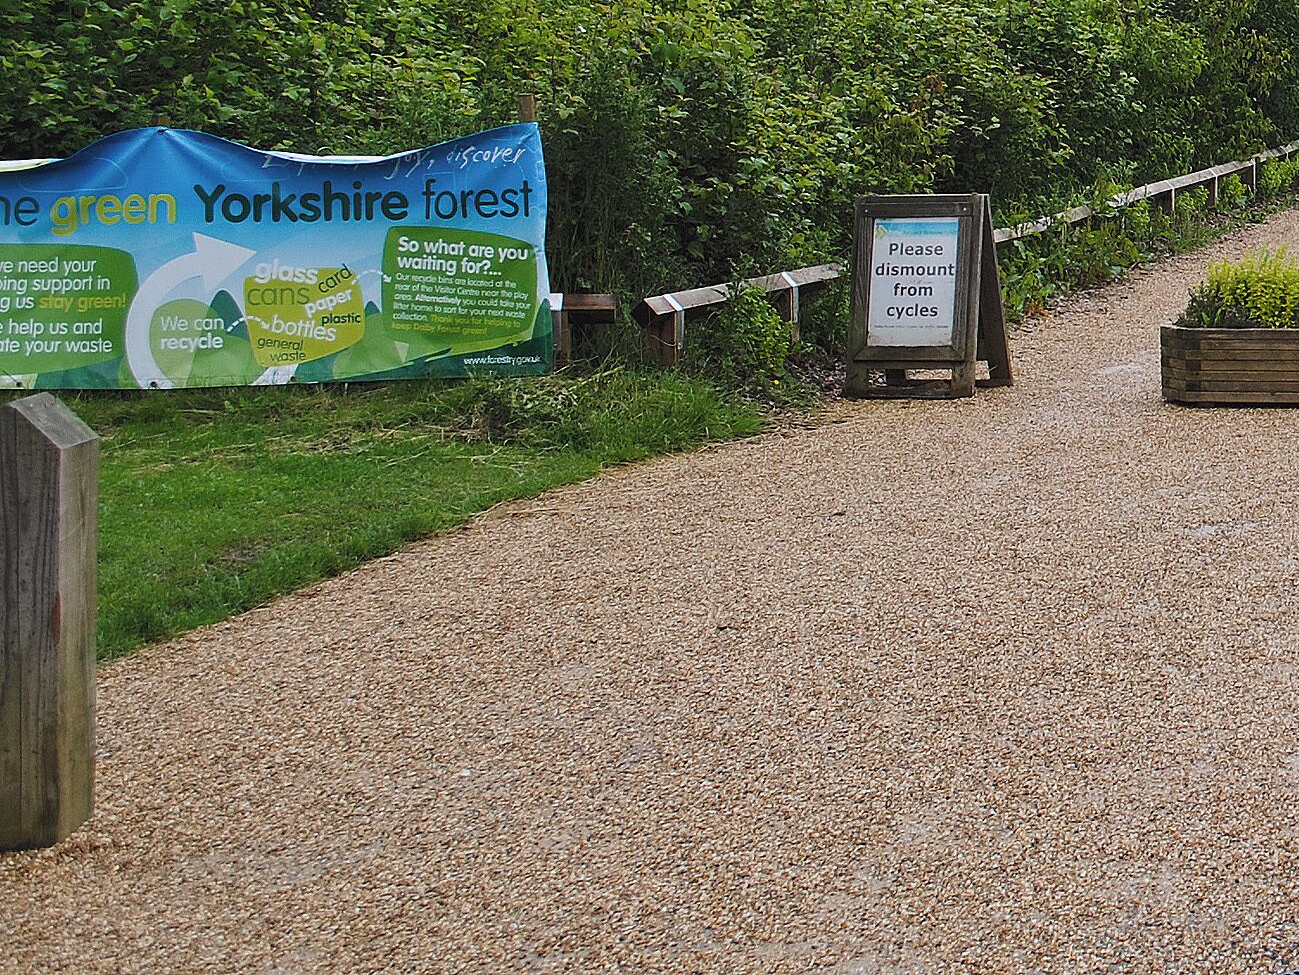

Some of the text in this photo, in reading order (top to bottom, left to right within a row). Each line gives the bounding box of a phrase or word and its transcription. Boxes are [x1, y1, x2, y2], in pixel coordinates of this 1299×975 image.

[50, 193, 176, 236] green
[193, 180, 410, 223] Yorkshire
[421, 178, 533, 220] forest
[397, 236, 528, 263] So what are you
[889, 242, 944, 256] Please
[18, 257, 58, 273] need
[63, 260, 97, 276] your
[254, 259, 318, 284] glass
[397, 254, 502, 276] waiting for?...
[875, 262, 955, 276] dismount
[32, 275, 93, 294] support
[97, 275, 111, 289] in
[318, 263, 352, 293] card
[411, 275, 436, 284] recycle
[438, 275, 453, 284] bins
[455, 278, 467, 286] are
[467, 278, 494, 287] located
[504, 280, 516, 288] the
[247, 287, 310, 306] cans
[420, 284, 433, 292] the
[434, 285, 456, 294] Visitor
[514, 291, 529, 301] play
[893, 282, 933, 296] from
[16, 297, 35, 309] us
[39, 294, 73, 312] stay
[77, 293, 126, 312] green!
[304, 289, 352, 318] paper
[411, 304, 433, 312] home
[434, 305, 442, 313] to
[458, 306, 468, 314] for
[415, 293, 462, 306] Alternatively
[477, 299, 498, 307] could
[515, 302, 531, 310] your
[321, 312, 361, 327] plastic
[886, 303, 939, 319] cycles
[9, 318, 44, 337] help
[49, 322, 68, 334] us
[73, 318, 103, 334] and
[160, 316, 225, 331] We can
[271, 314, 337, 342] bottles
[25, 340, 61, 356] your
[65, 338, 113, 352] waste
[160, 332, 224, 353] recycle
[257, 337, 304, 351] general
[270, 351, 307, 362] waste
